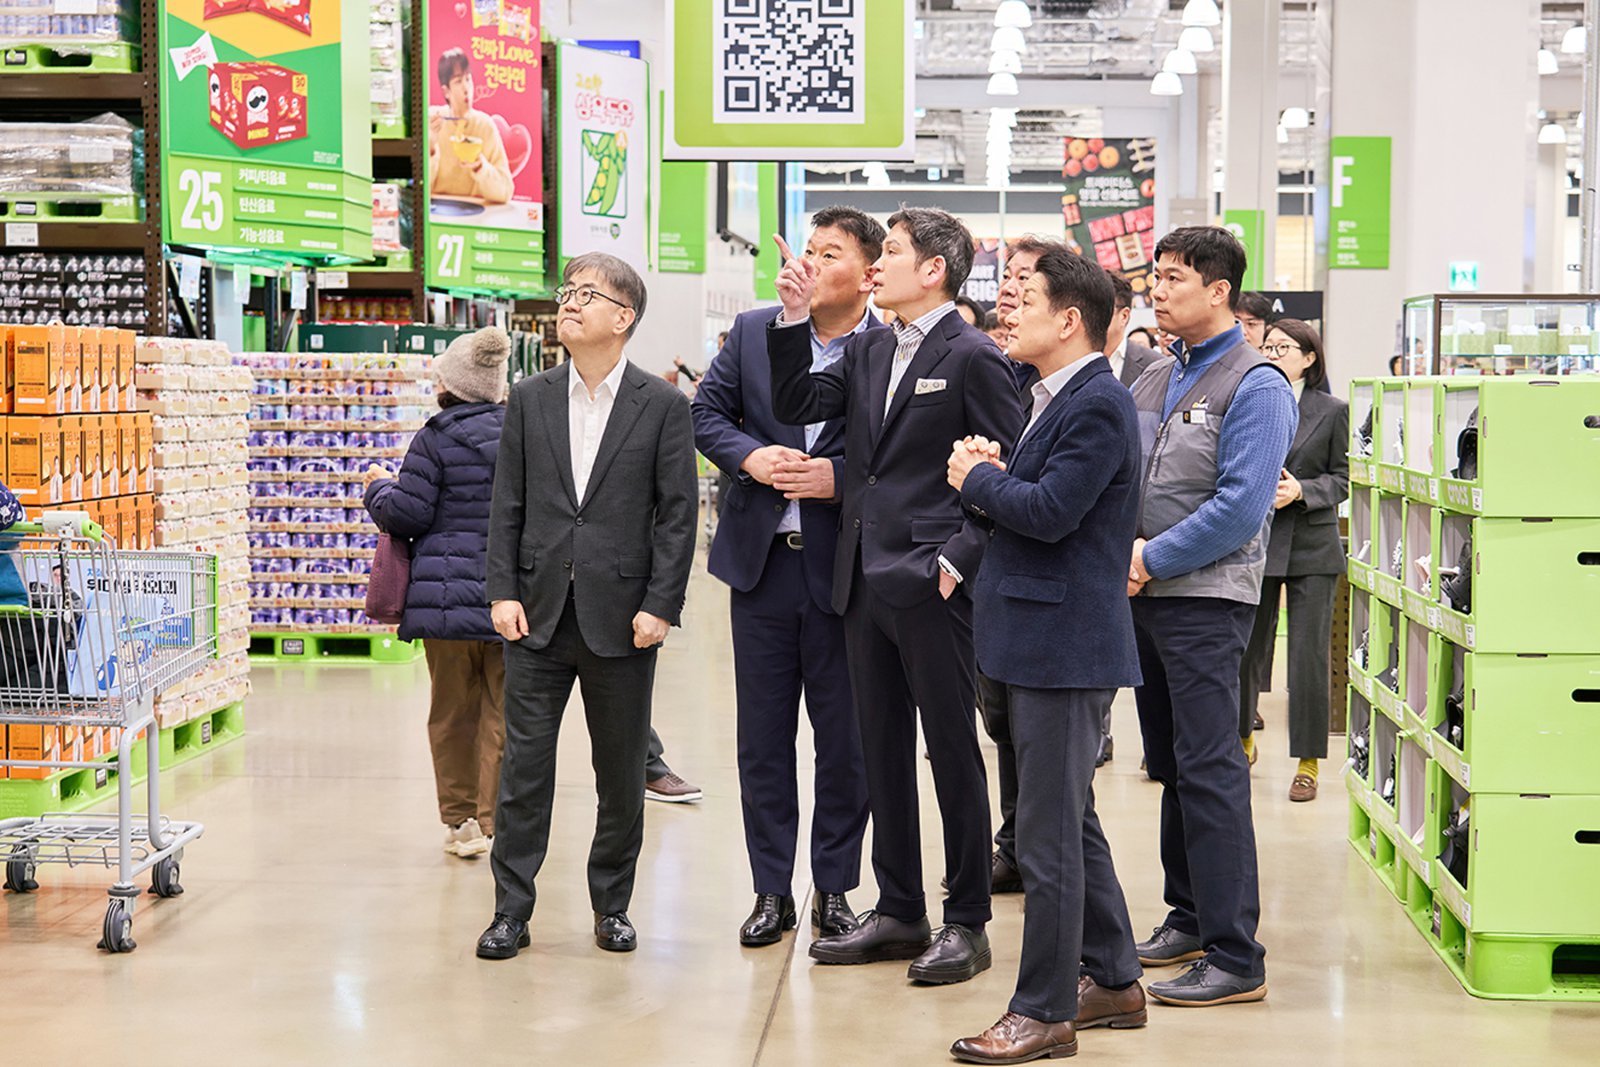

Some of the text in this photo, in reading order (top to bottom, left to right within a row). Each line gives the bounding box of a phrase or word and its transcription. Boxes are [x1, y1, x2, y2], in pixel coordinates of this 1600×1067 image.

[471, 36, 498, 61] 진짜
[484, 63, 526, 93] 진라면
[238, 168, 287, 186] 커피/티음료
[1332, 156, 1354, 208] F
[179, 169, 223, 231] 25
[239, 197, 275, 213] 탄산음료
[239, 228, 285, 244] 기능성음료
[437, 233, 464, 277] 27
